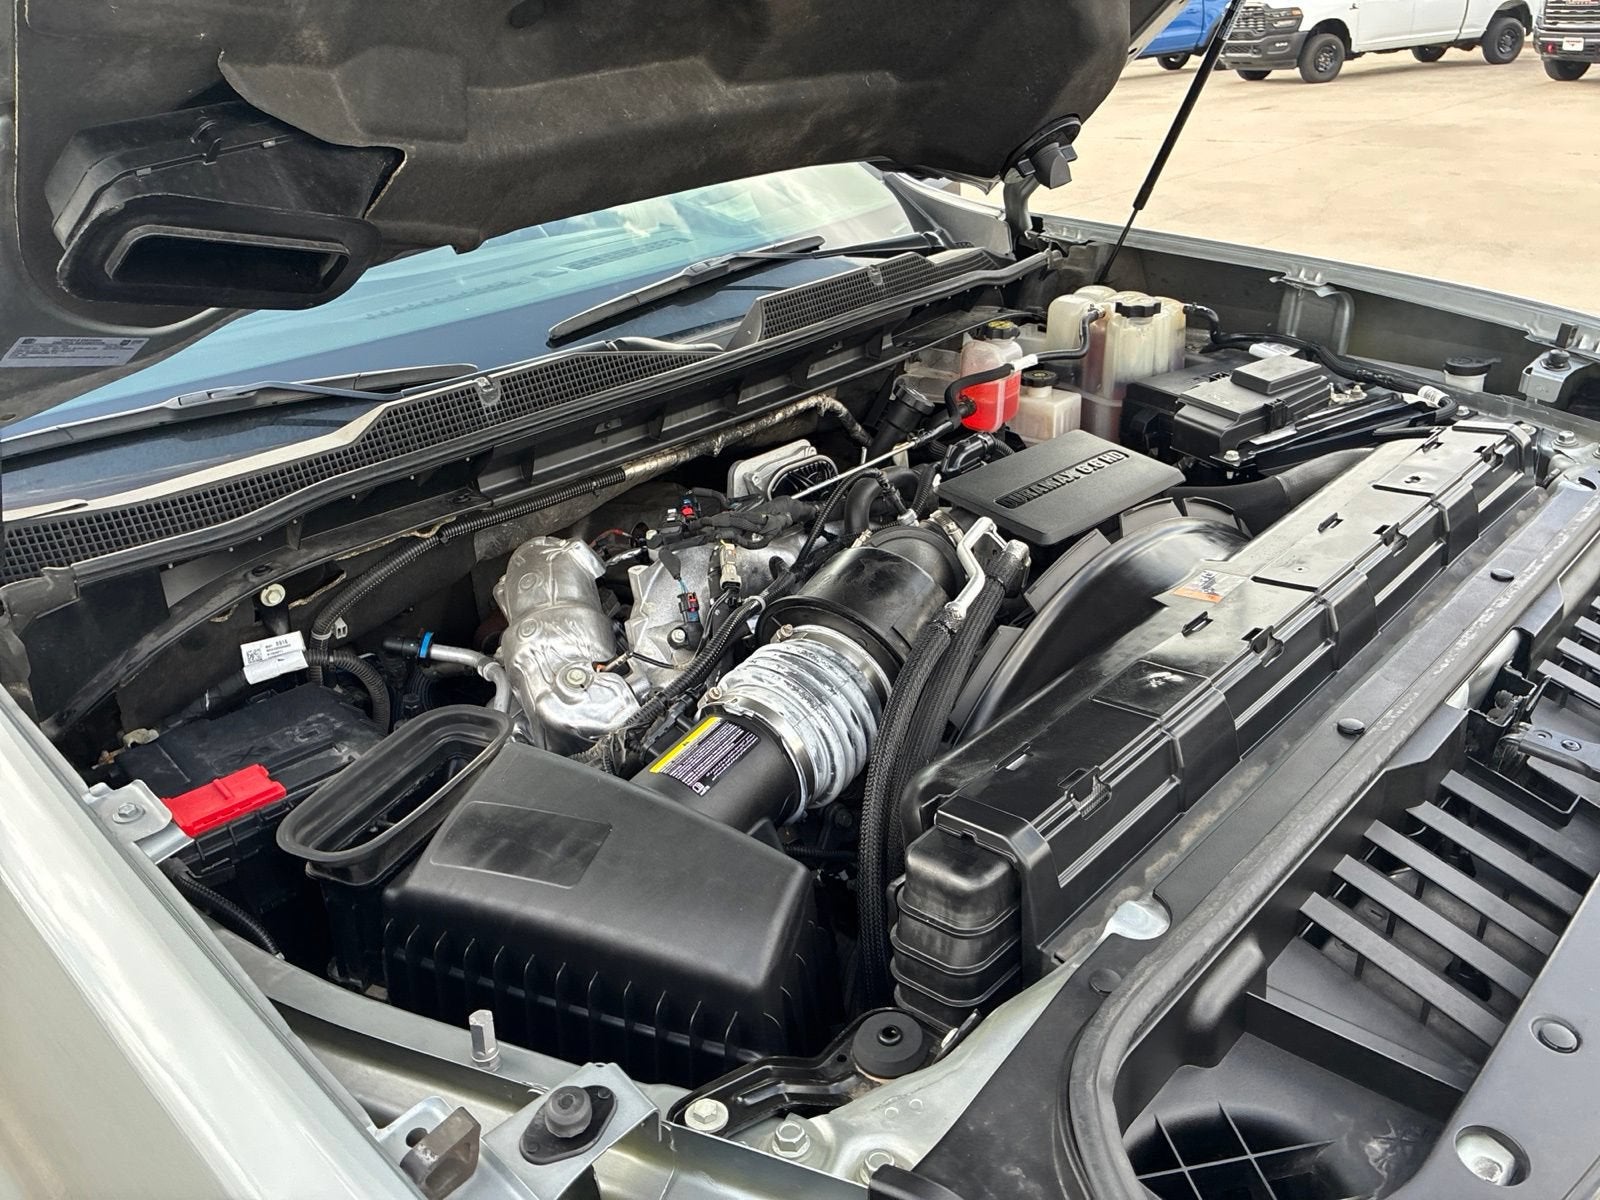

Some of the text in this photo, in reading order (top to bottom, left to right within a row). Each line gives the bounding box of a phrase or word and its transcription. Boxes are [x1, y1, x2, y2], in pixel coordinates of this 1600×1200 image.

[998, 452, 1125, 508] DURAMAX 6.6 HD
